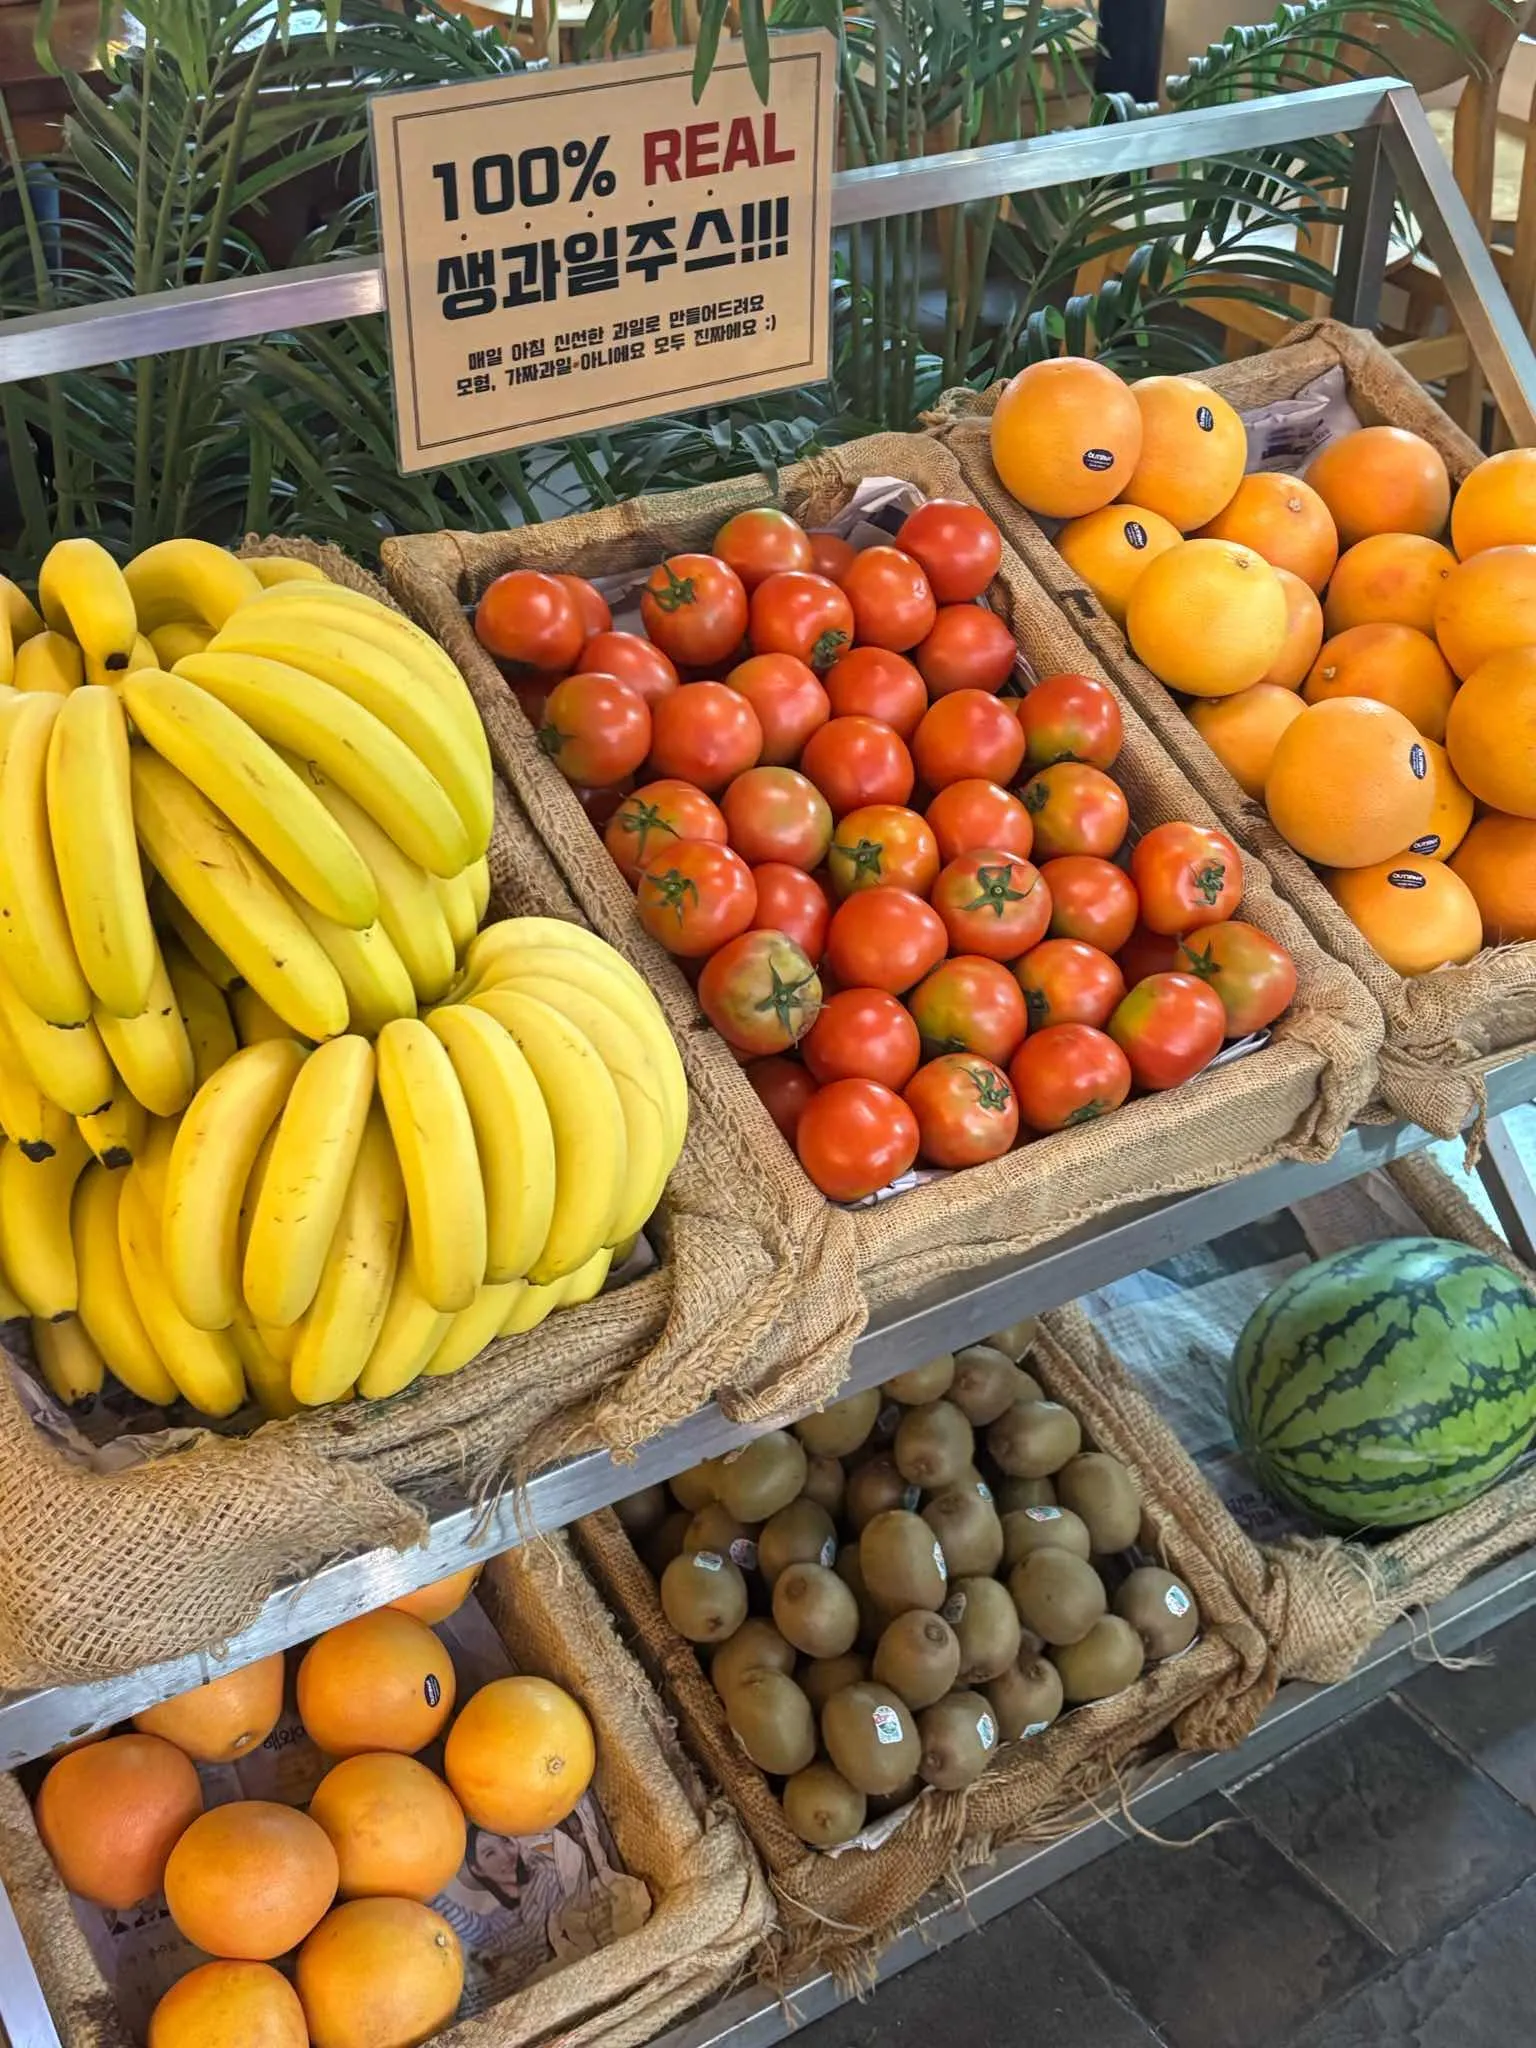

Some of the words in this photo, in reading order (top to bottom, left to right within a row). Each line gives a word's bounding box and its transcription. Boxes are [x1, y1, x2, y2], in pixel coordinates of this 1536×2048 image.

[433, 135, 616, 221] 100%
[643, 112, 795, 186] REAL
[437, 196, 789, 320] 생과일주스!!!
[457, 373, 496, 397] 모형,
[505, 357, 572, 386] 가짜과일
[581, 342, 645, 371] 아니에요
[654, 333, 685, 354] 모두
[694, 319, 757, 347] 진짜에요
[468, 347, 503, 371] 매일
[512, 338, 545, 361] 아침
[554, 326, 604, 352] 신선한
[613, 315, 660, 340] 과일로
[669, 294, 764, 328] 만들어드려요
